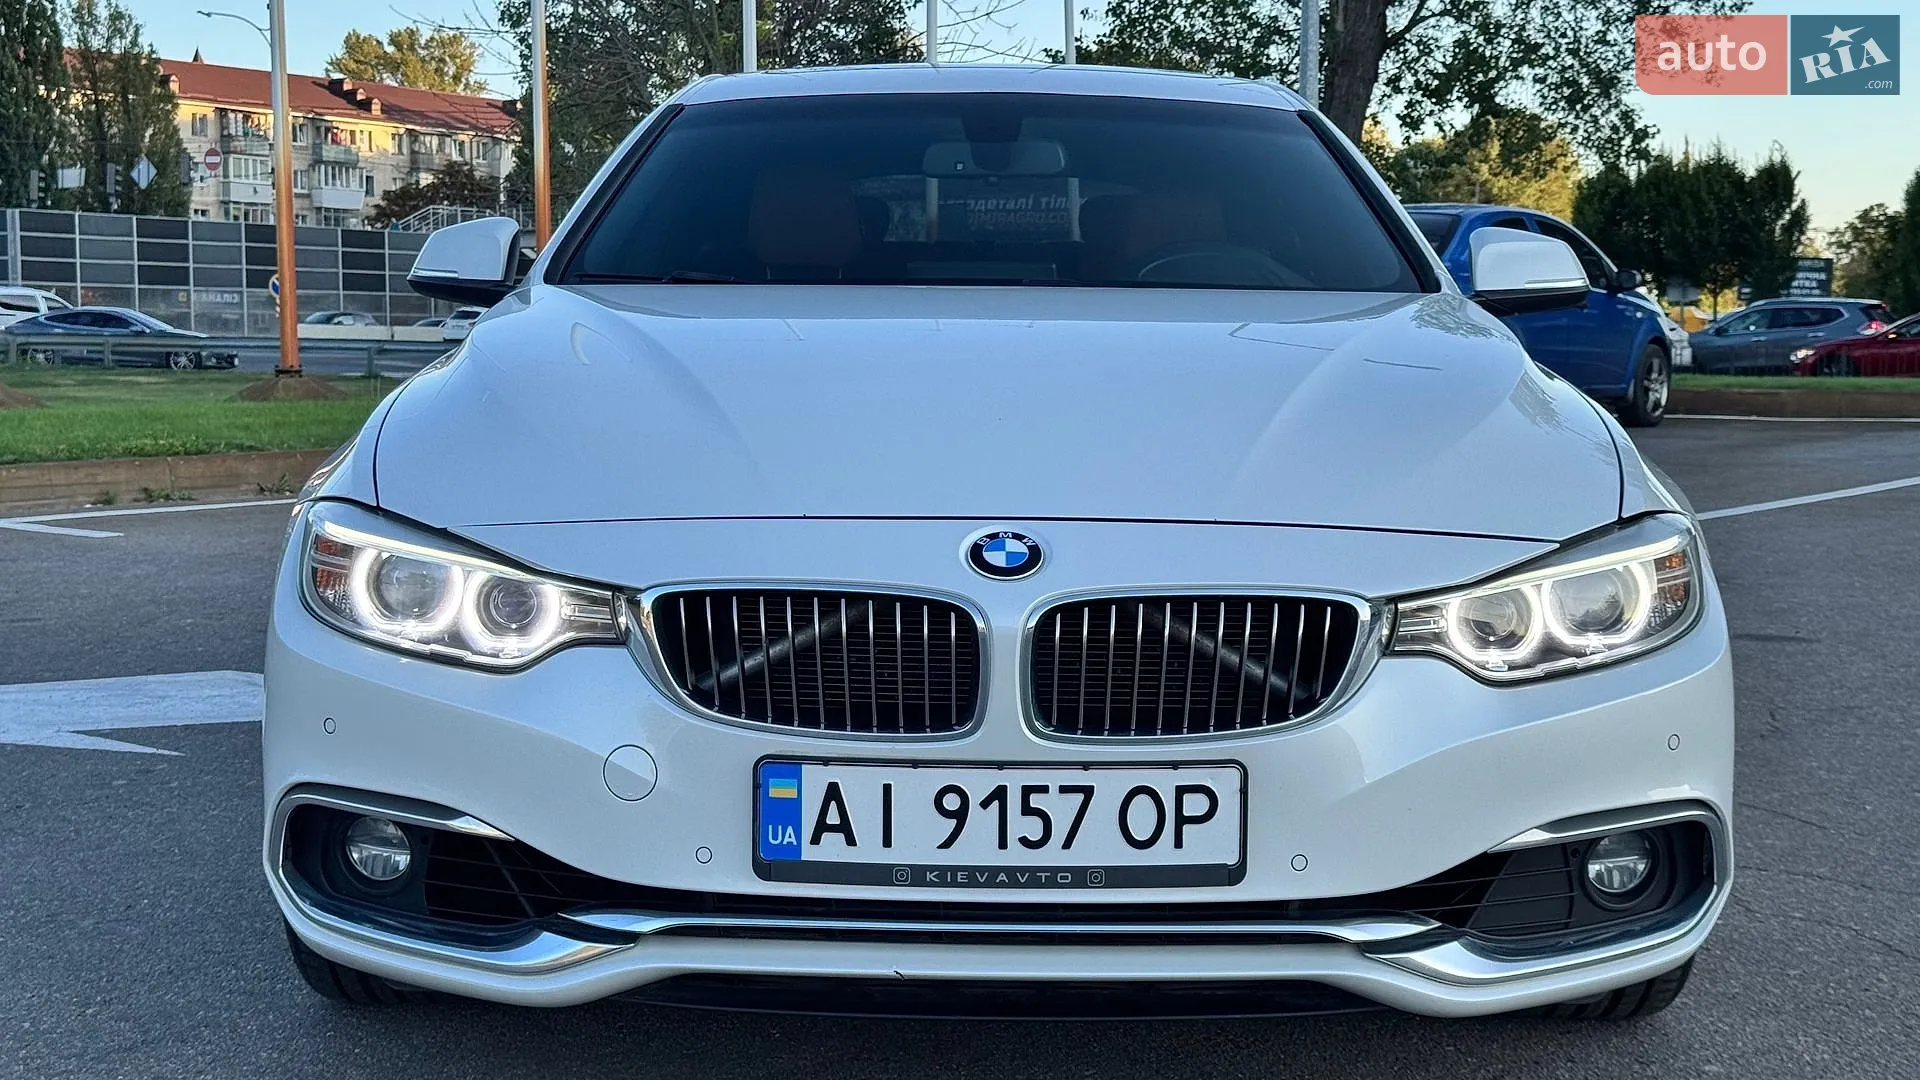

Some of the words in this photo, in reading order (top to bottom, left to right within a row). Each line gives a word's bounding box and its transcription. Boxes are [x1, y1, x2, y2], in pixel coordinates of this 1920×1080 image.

[976, 531, 1037, 547] BMW
[808, 781, 893, 849] AI
[933, 783, 1096, 850] 9157
[1118, 783, 1219, 850] OP
[768, 825, 797, 845] UA
[926, 871, 1072, 884] KIEVAVTO
